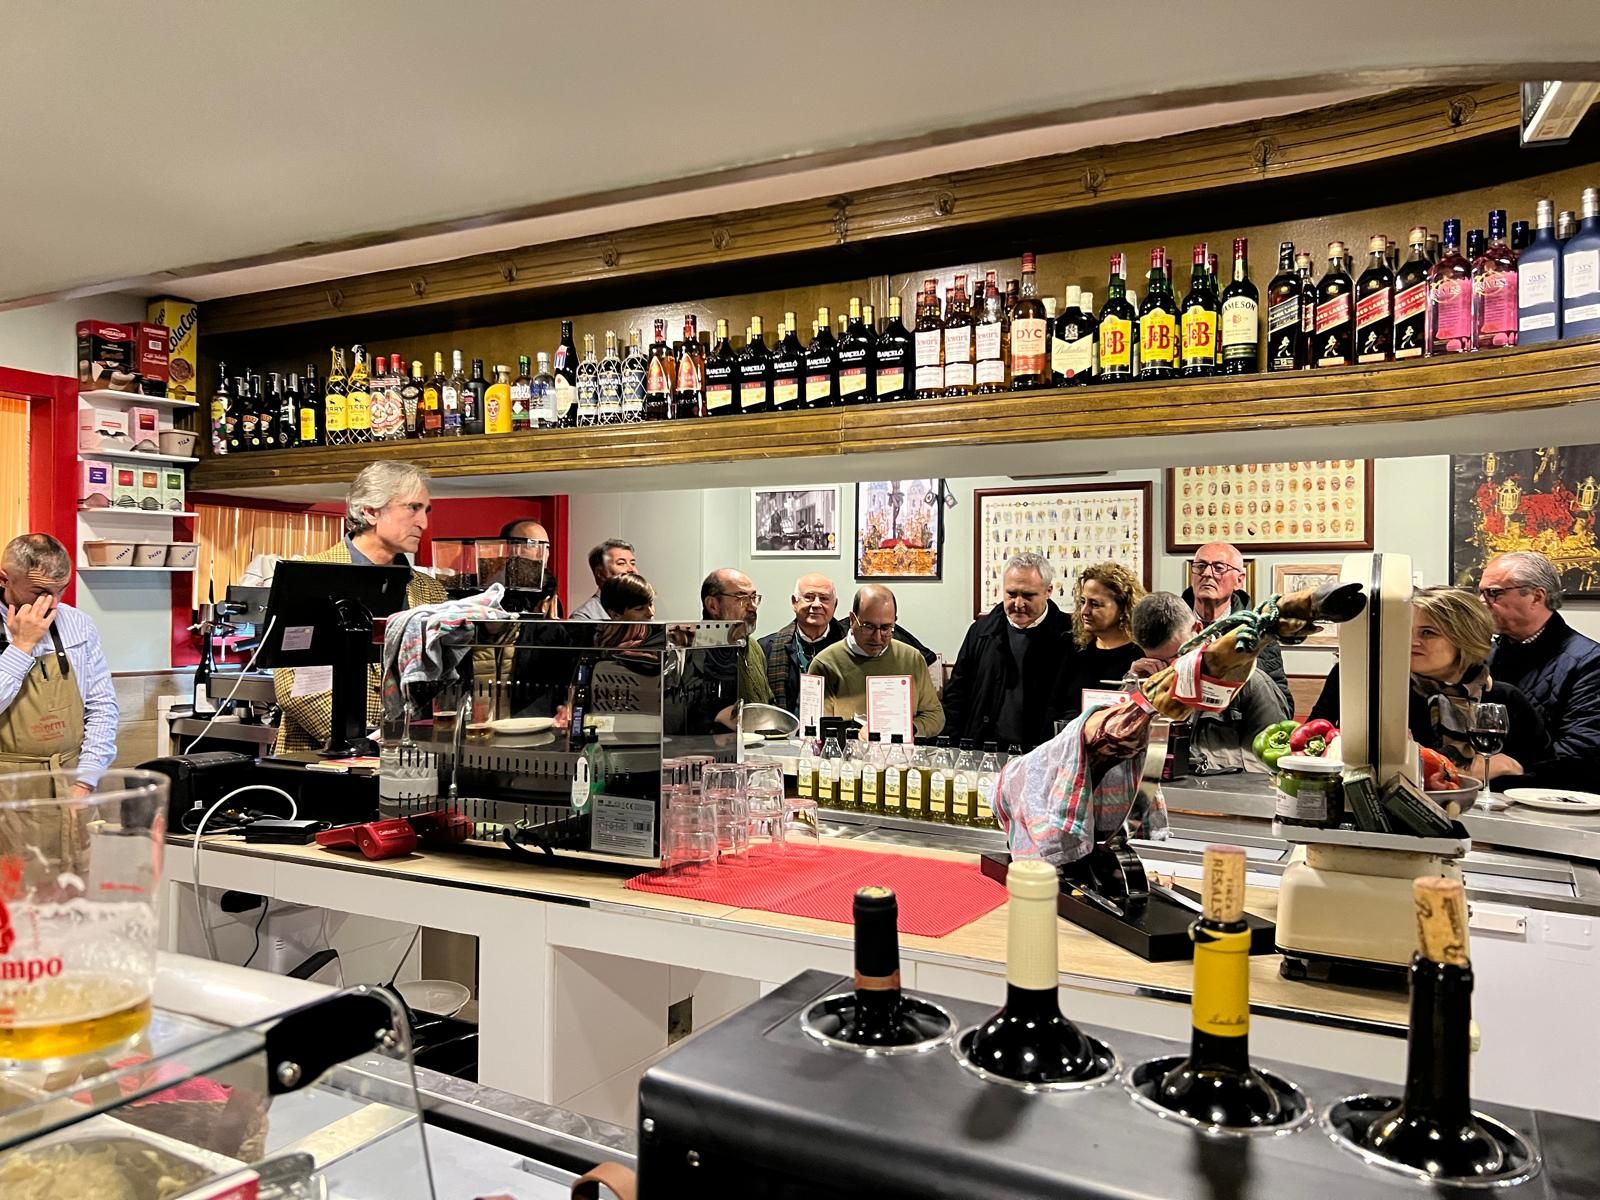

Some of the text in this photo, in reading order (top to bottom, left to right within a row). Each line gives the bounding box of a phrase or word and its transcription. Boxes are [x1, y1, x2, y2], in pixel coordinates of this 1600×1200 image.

[1016, 328, 1043, 339] DYC
[1101, 330, 1125, 357] J&B
[1143, 324, 1171, 350] J&B
[0, 957, 64, 983] mpo
